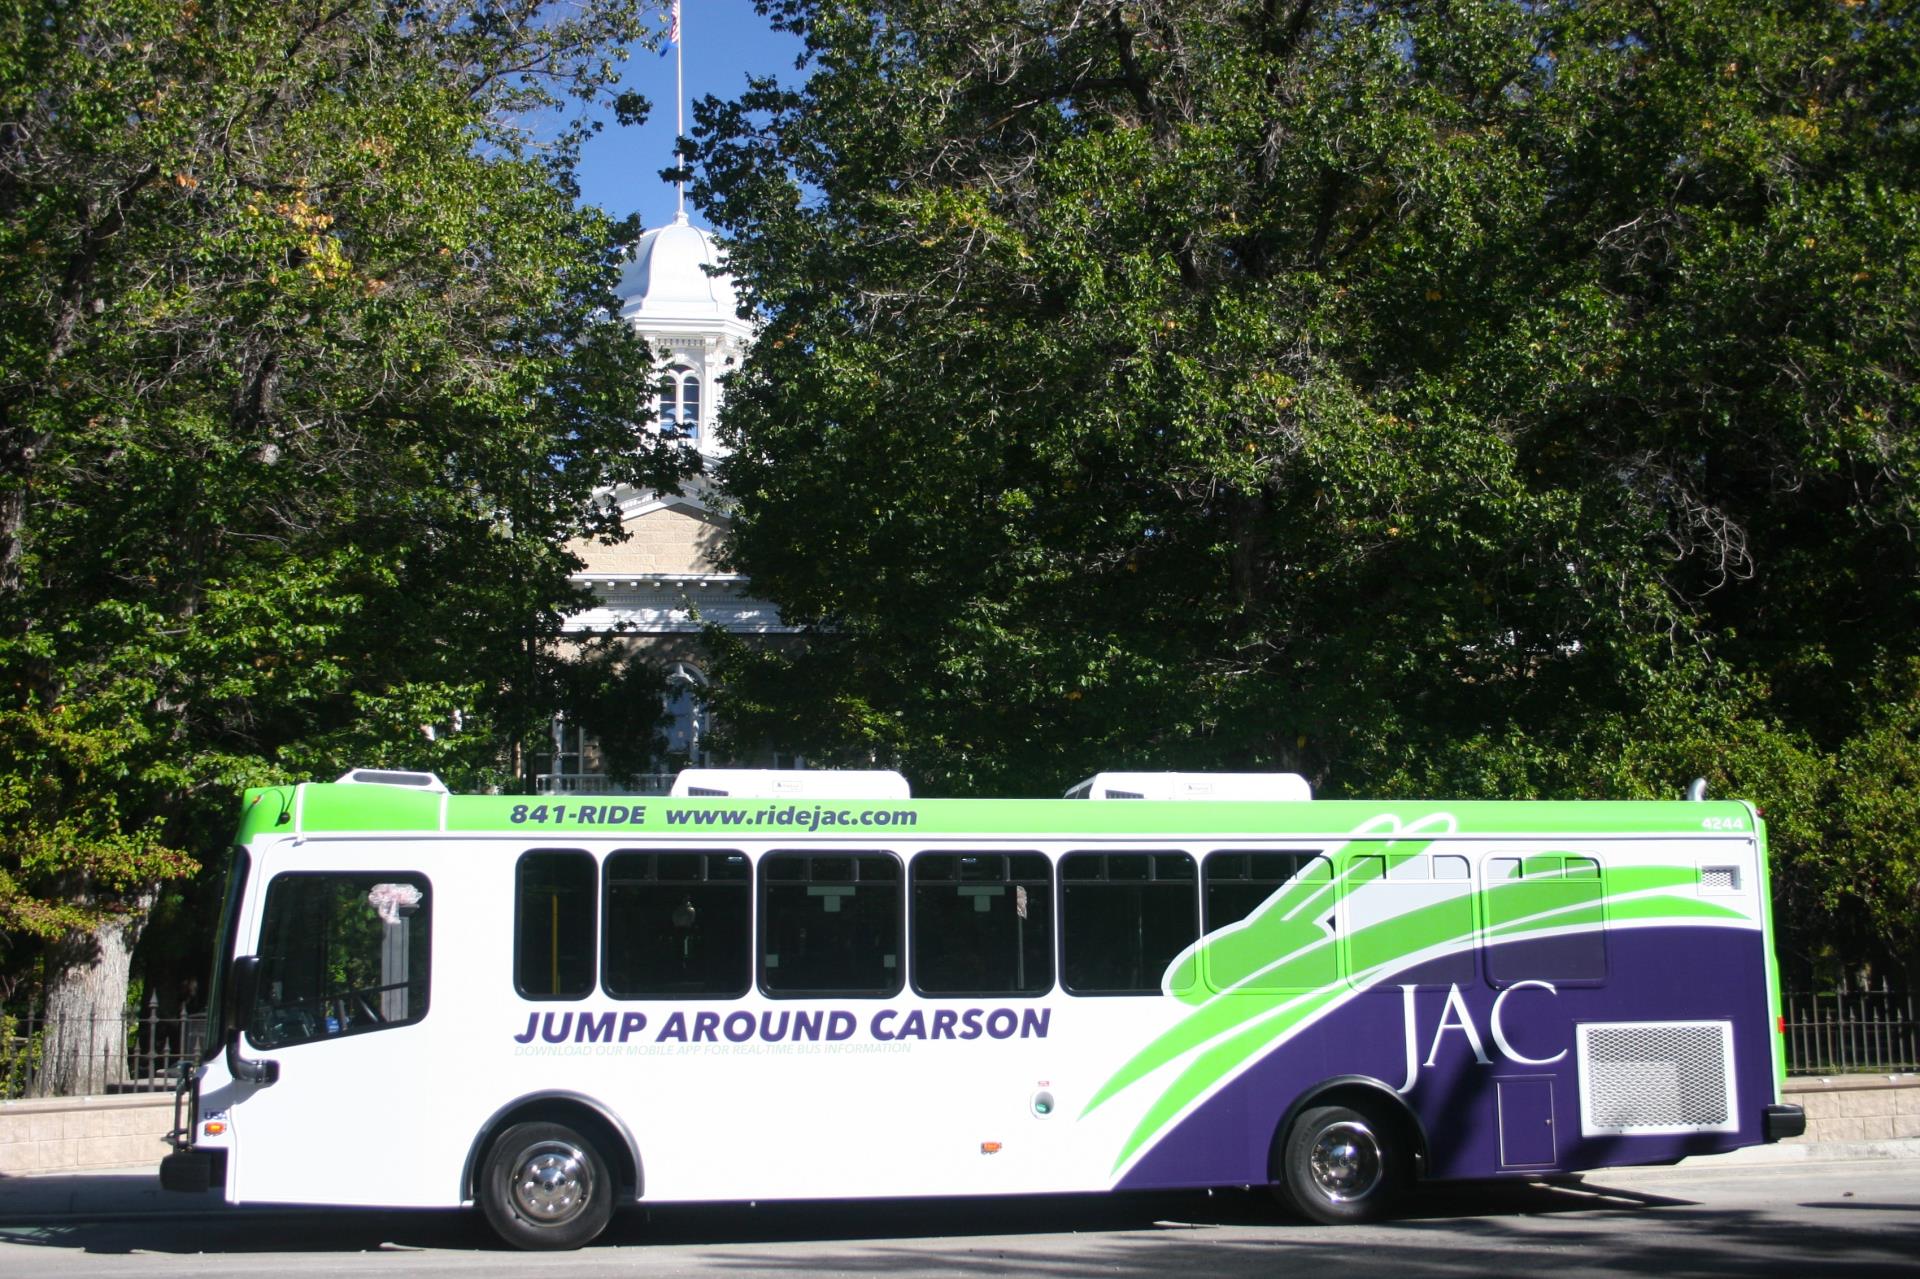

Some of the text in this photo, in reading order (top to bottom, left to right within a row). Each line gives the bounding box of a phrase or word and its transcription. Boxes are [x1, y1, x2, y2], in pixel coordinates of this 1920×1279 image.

[509, 804, 647, 825] 841-RIDE
[666, 804, 918, 832] www.ridejac.com
[513, 1007, 1052, 1044] JUMP AROUND CARSON
[1396, 979, 1568, 1095] JAC
[514, 1045, 591, 1057] DOWNLOAD
[594, 1044, 623, 1056] OUR
[626, 1044, 675, 1056] MOBILE
[676, 1044, 702, 1055] APP
[703, 1044, 730, 1055] FOR
[797, 1043, 821, 1054] BUS
[824, 1042, 912, 1055] INFORMATION
